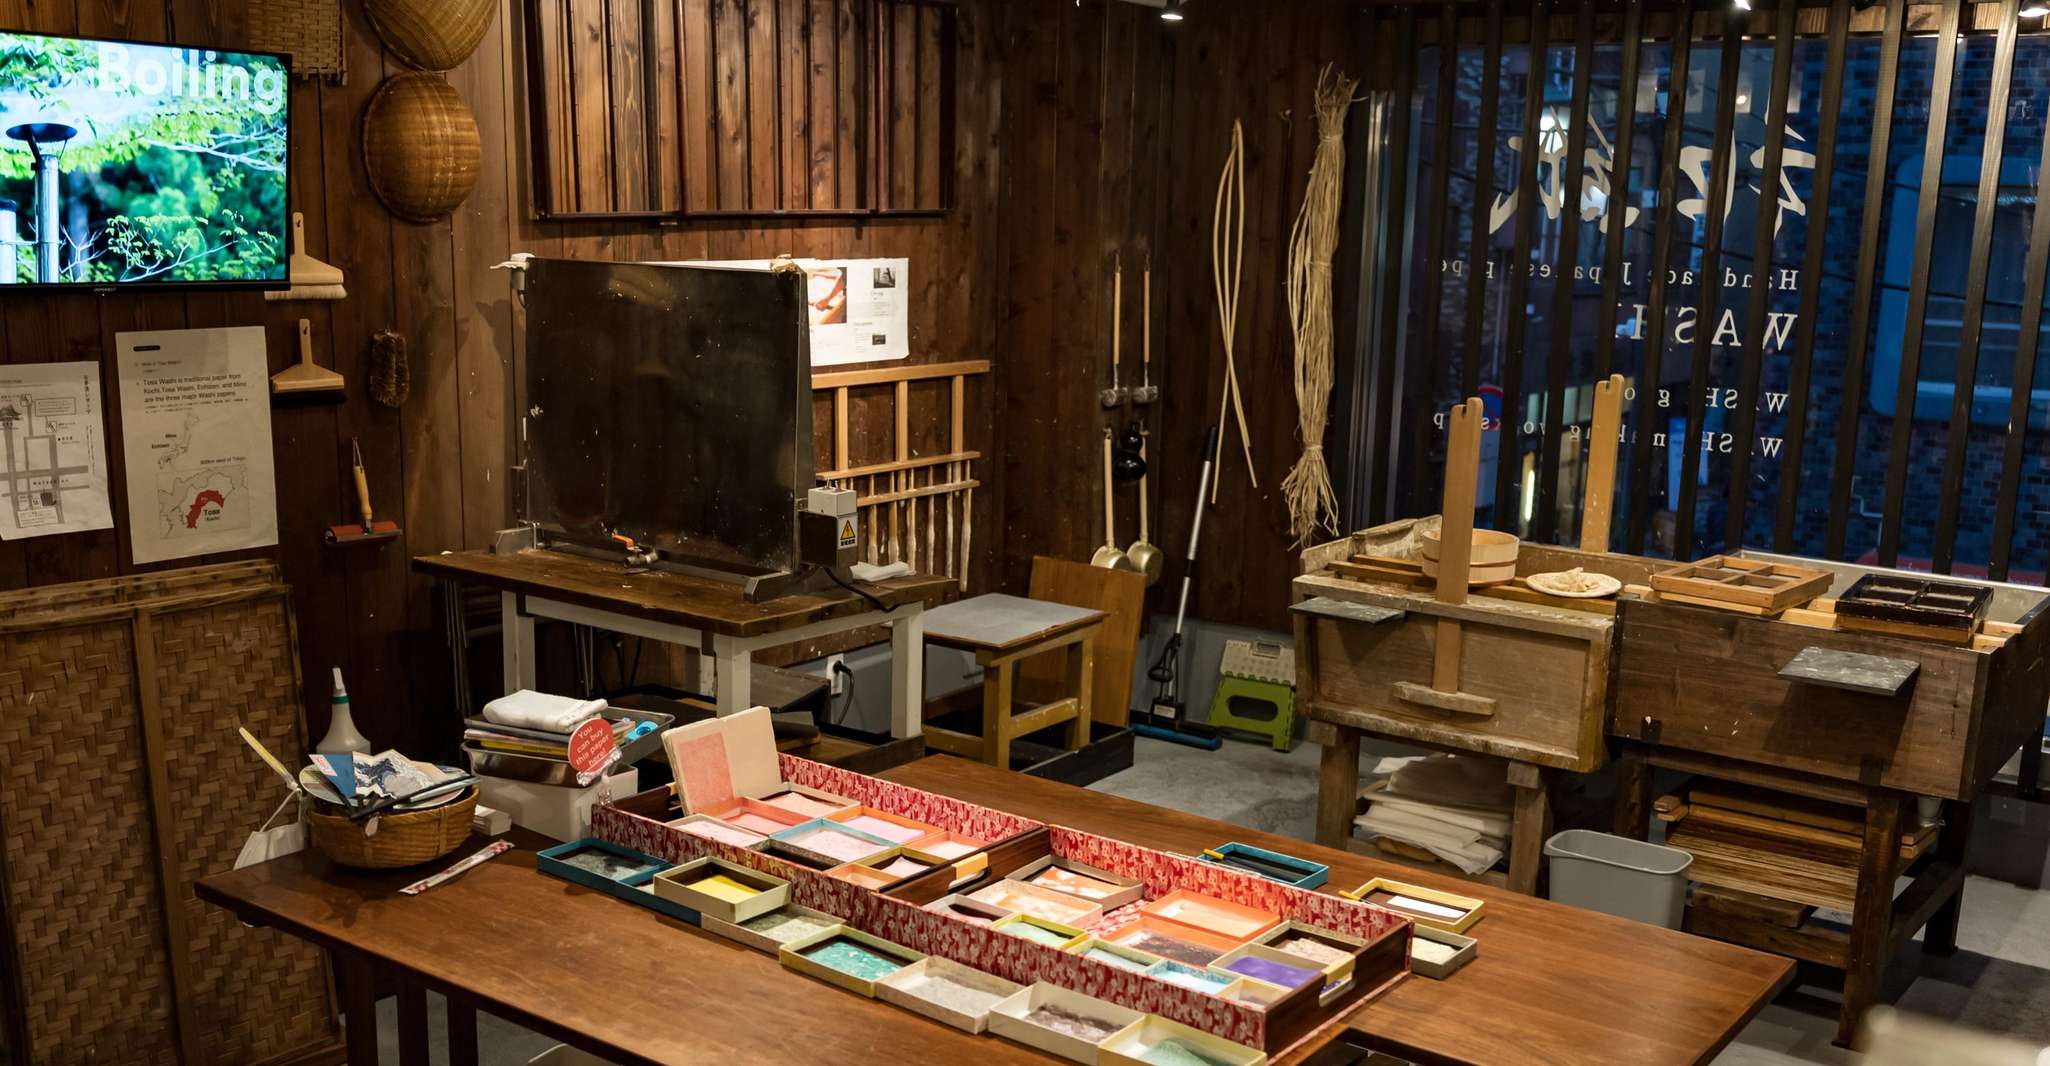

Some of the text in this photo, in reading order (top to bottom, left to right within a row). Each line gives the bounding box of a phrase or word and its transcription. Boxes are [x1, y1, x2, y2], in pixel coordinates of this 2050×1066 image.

[98, 43, 282, 115] Boiling
[576, 728, 604, 753] can buy
[578, 726, 593, 738] You
[576, 734, 609, 765] this paper
